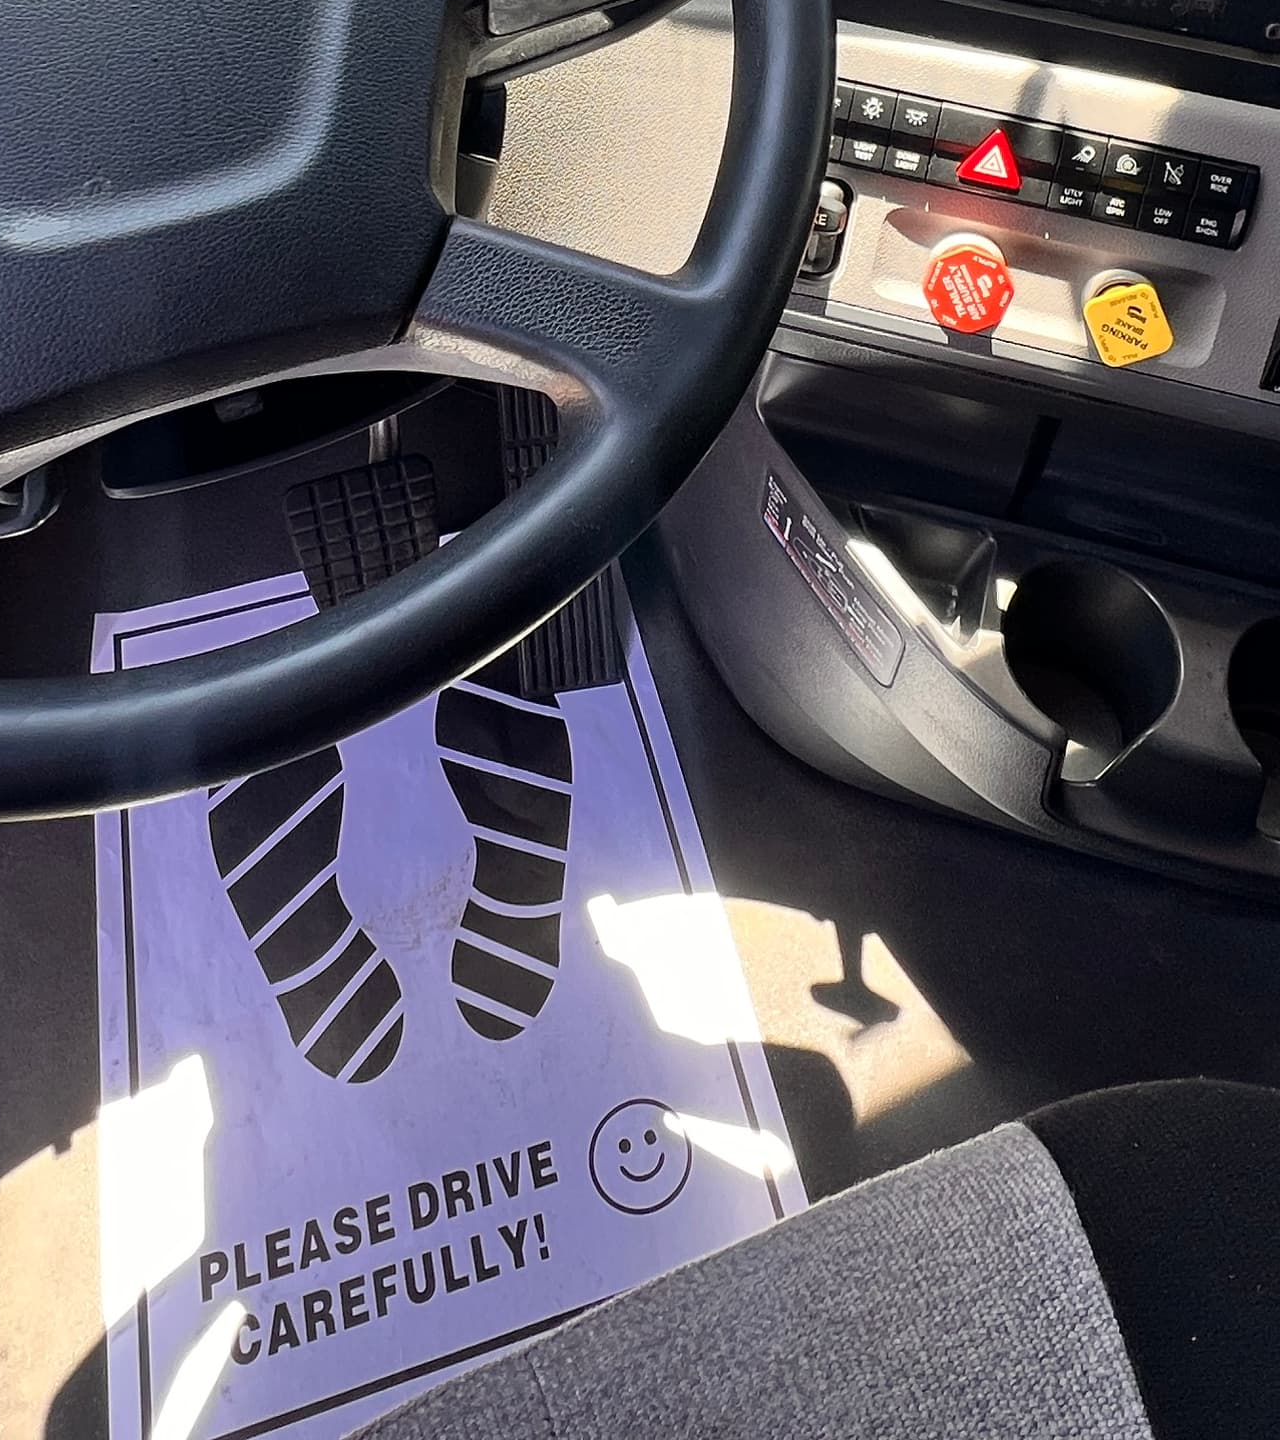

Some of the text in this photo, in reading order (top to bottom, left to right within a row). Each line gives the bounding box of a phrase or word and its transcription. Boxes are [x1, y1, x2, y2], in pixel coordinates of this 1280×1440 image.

[853, 141, 878, 154] LIGHT
[854, 150, 874, 161] TEST
[895, 160, 920, 172] LIGHT
[1210, 174, 1233, 185] OVER
[1064, 188, 1083, 197] UTLY
[1210, 183, 1229, 194] RIDE
[1060, 196, 1083, 207] LIGHT
[1109, 197, 1125, 208] ATC
[1153, 216, 1169, 225] OFF
[1200, 218, 1218, 228] ENG
[948, 265, 972, 303] SUPPLY
[942, 275, 966, 317] TRAILER
[1114, 317, 1144, 336] BRAKE
[1099, 321, 1148, 350] PARKING
[200, 1140, 559, 1303] PLEASE DRIVE
[231, 1213, 550, 1366] CAREFULLY!
